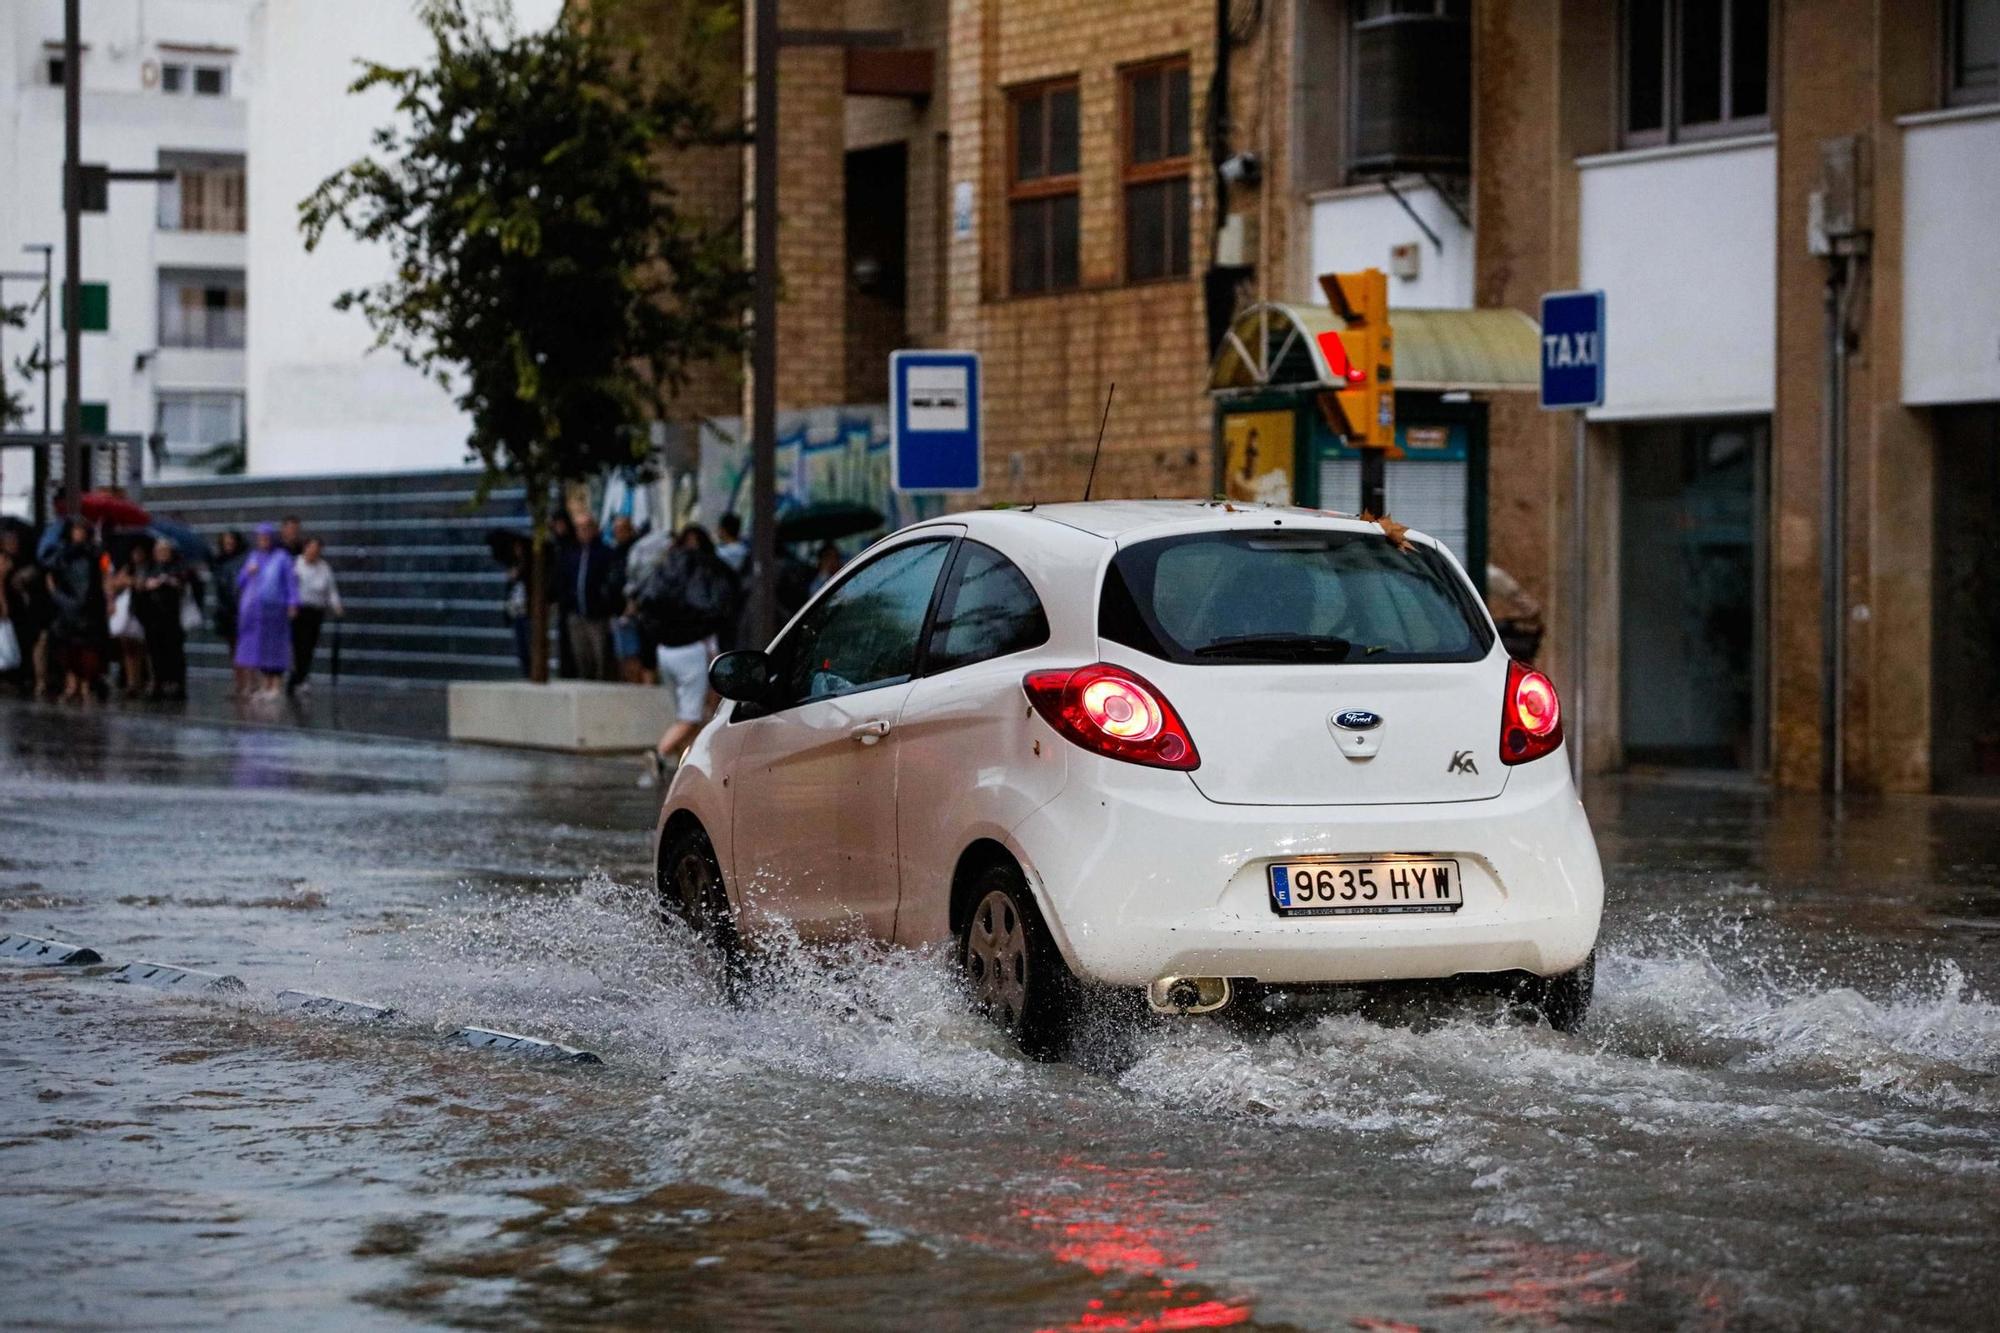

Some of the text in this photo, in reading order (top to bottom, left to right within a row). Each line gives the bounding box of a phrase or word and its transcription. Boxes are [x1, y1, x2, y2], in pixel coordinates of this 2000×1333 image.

[1544, 332, 1598, 368] TAXI
[1344, 712, 1372, 723] Ford
[1294, 867, 1450, 901] 9635 HYW
[1278, 891, 1286, 900] E
